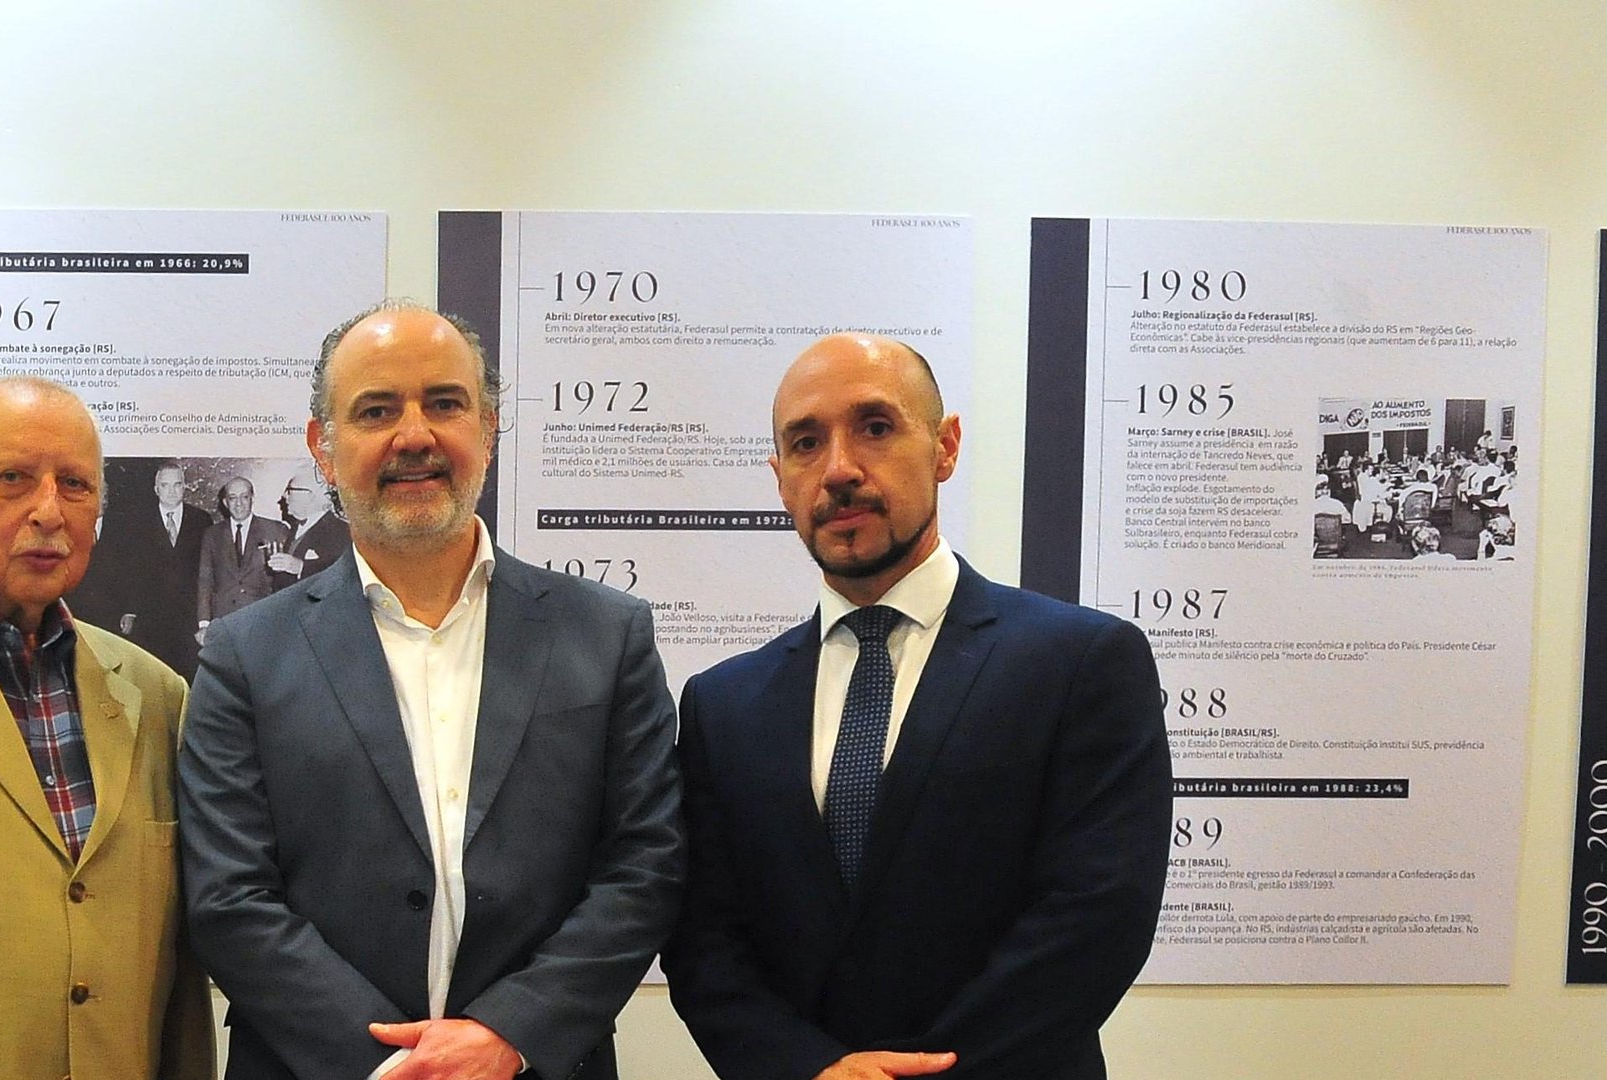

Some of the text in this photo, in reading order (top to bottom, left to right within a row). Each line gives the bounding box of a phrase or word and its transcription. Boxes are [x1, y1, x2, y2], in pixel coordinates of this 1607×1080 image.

[61, 257, 129, 267] brasileira
[159, 257, 196, 268] 1966:
[202, 258, 243, 270] 20,9%
[553, 270, 659, 306] 1970
[1139, 269, 1247, 304] 1980
[544, 311, 681, 324] Abril: Diretor executivo [RS].
[1130, 309, 1161, 319] Julho:
[1162, 309, 1233, 323] Regionalização
[1247, 311, 1294, 321] Federasul
[1294, 311, 1318, 323] [RS].
[39, 343, 91, 356] sonegação
[92, 343, 117, 355] [RS].
[552, 380, 650, 416] 1972
[1136, 383, 1235, 420] 1985
[1319, 414, 1339, 423] DIGA
[542, 422, 709, 434] Junho: Unimed Federação/RS [RS].
[1127, 427, 1159, 438] Março:
[1161, 427, 1194, 439] Sarney
[1202, 427, 1226, 437] crise
[1227, 427, 1271, 439] [BRASIL].
[541, 514, 579, 526] Carga
[584, 513, 653, 525] tributária
[658, 514, 726, 525] Brasileira
[755, 515, 792, 525] 1972:
[1131, 587, 1229, 622] 1987
[1147, 627, 1218, 639] Manifesto [RS].
[1160, 687, 1228, 720] 88
[1166, 727, 1280, 740] onstituição [BRASIL/RS].
[1172, 782, 1227, 792] ibutária
[1231, 782, 1296, 792] brasileira
[1325, 783, 1359, 793] 1988:
[1364, 783, 1403, 794] 23,4%
[1173, 816, 1223, 851] 89
[1168, 857, 1231, 869] ACB [BRASIL].
[1582, 760, 1607, 954] 1990 2000
[1190, 902, 1234, 913] [BRASIL].
